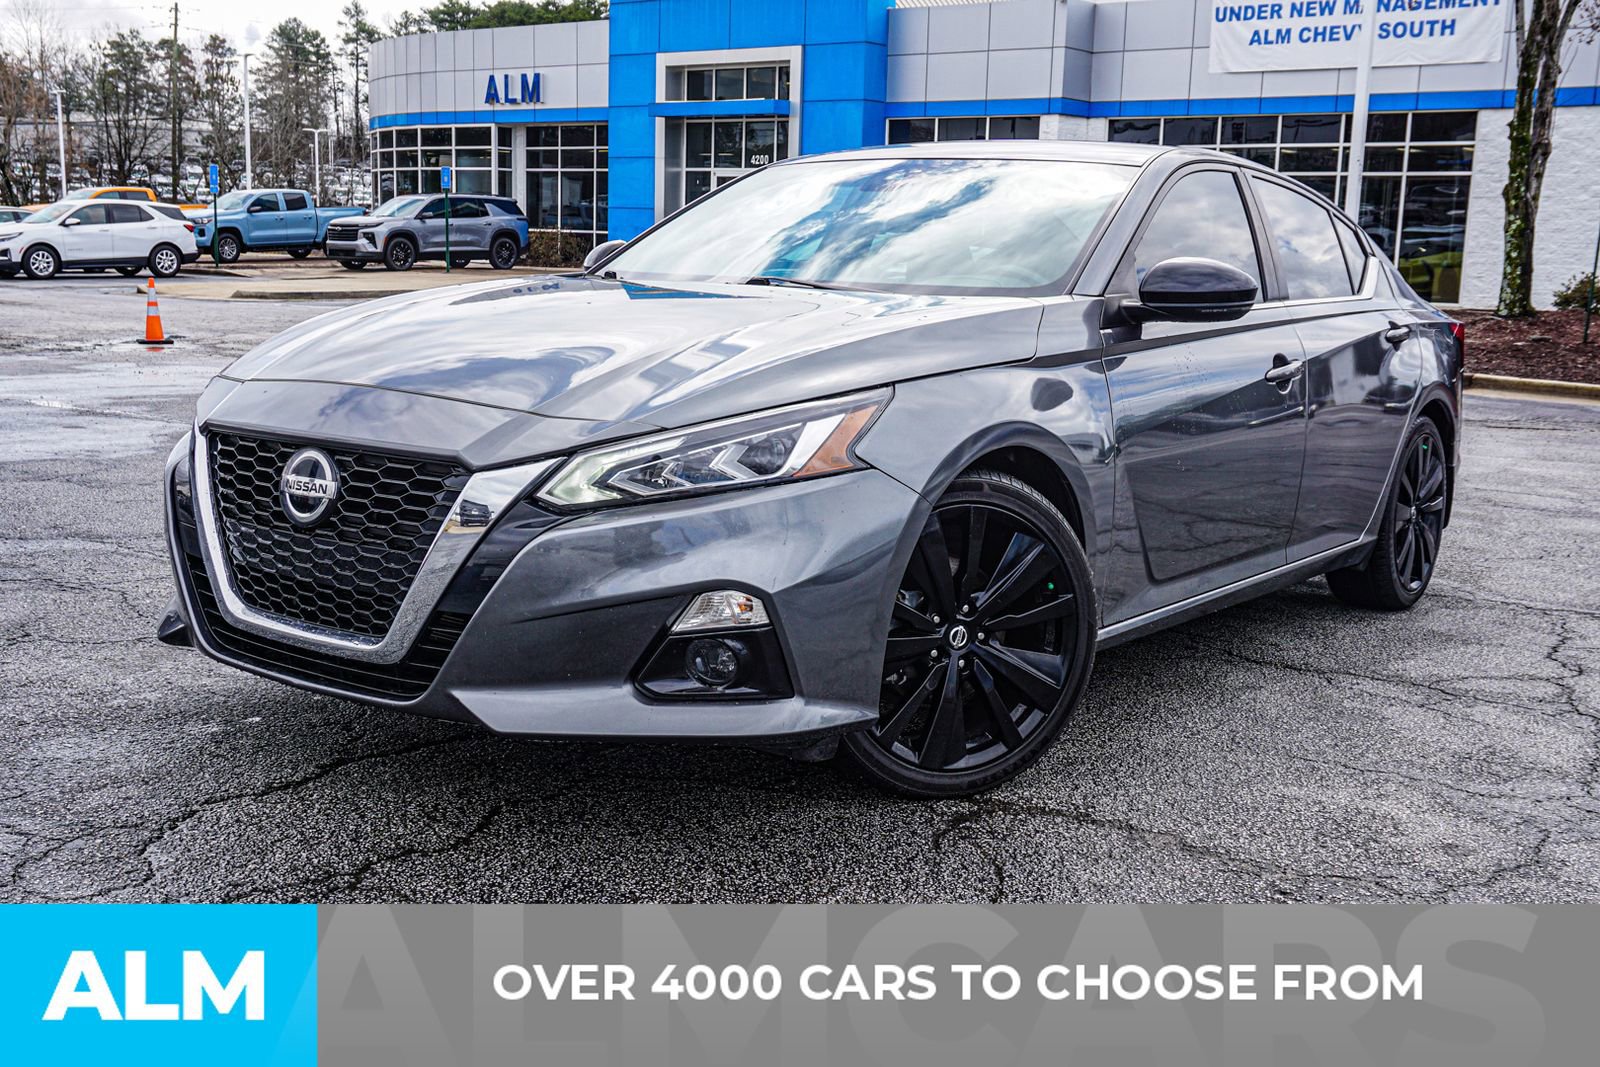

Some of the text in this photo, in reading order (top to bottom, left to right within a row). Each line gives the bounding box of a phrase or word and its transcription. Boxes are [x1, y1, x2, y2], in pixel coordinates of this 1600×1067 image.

[1215, 3, 1283, 22] UNDER
[1289, 0, 1336, 17] NEW
[1248, 18, 1456, 46] ALM CHEV SOUTH
[484, 73, 541, 104] ALM
[750, 154, 770, 165] 4200
[286, 479, 328, 495] NISSAN
